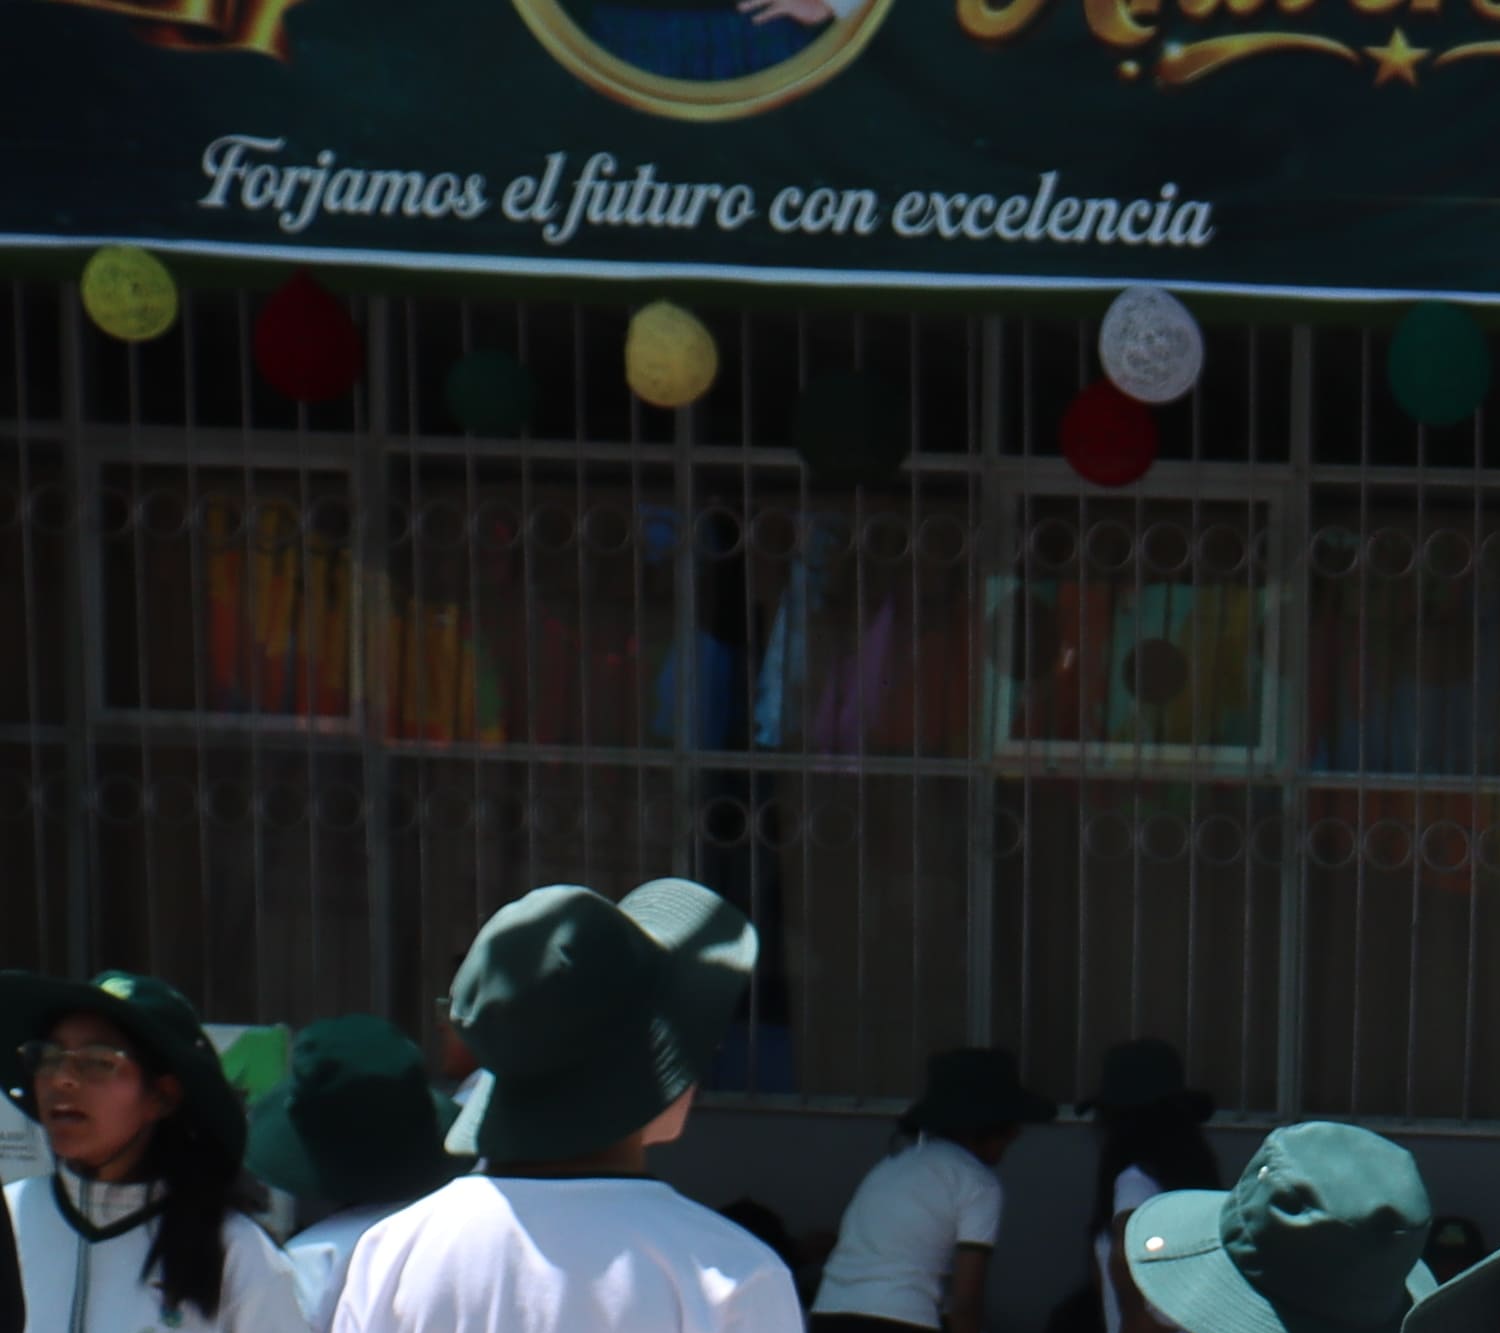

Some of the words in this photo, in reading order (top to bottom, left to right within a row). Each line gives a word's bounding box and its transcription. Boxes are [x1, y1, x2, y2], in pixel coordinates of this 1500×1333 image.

[200, 134, 487, 233] Forjamos
[501, 151, 566, 221] el
[542, 152, 755, 245] futuro
[768, 183, 879, 234] con
[892, 171, 1216, 247] excelencia
